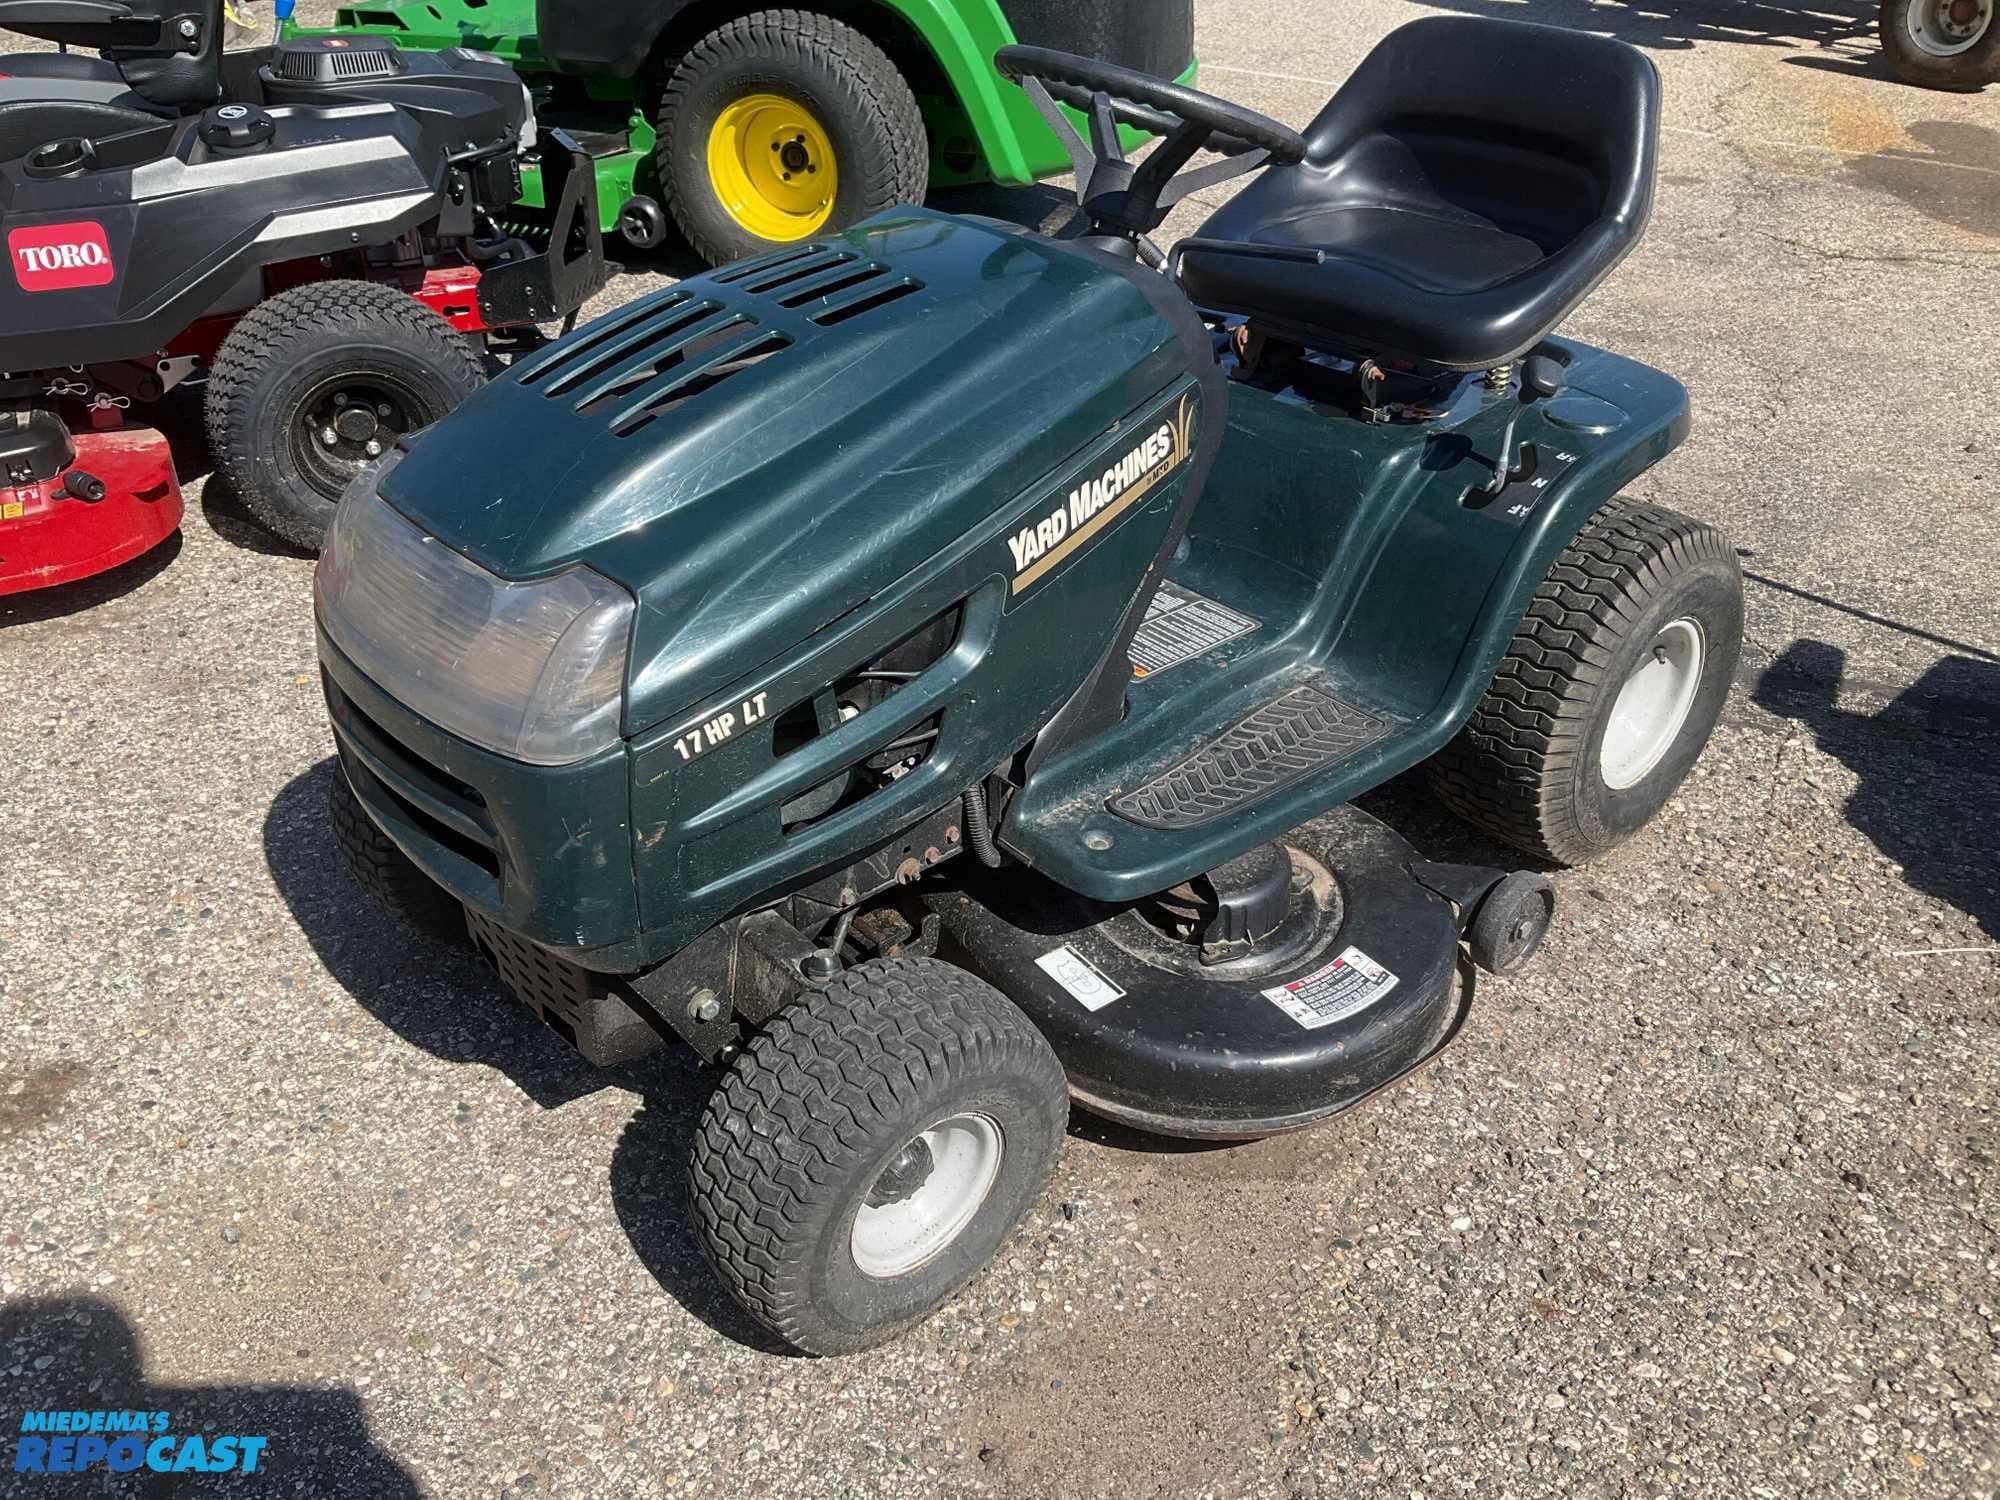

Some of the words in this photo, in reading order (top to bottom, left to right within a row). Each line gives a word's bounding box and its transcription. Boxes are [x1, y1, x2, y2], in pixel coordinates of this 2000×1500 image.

[18, 241, 103, 272] TORO
[1007, 508, 1067, 572] YARD
[1069, 424, 1171, 530] MACHINES
[673, 729, 703, 760] 17
[703, 712, 736, 745] HP
[742, 691, 768, 725] LT
[1303, 964, 1337, 985] DANGER
